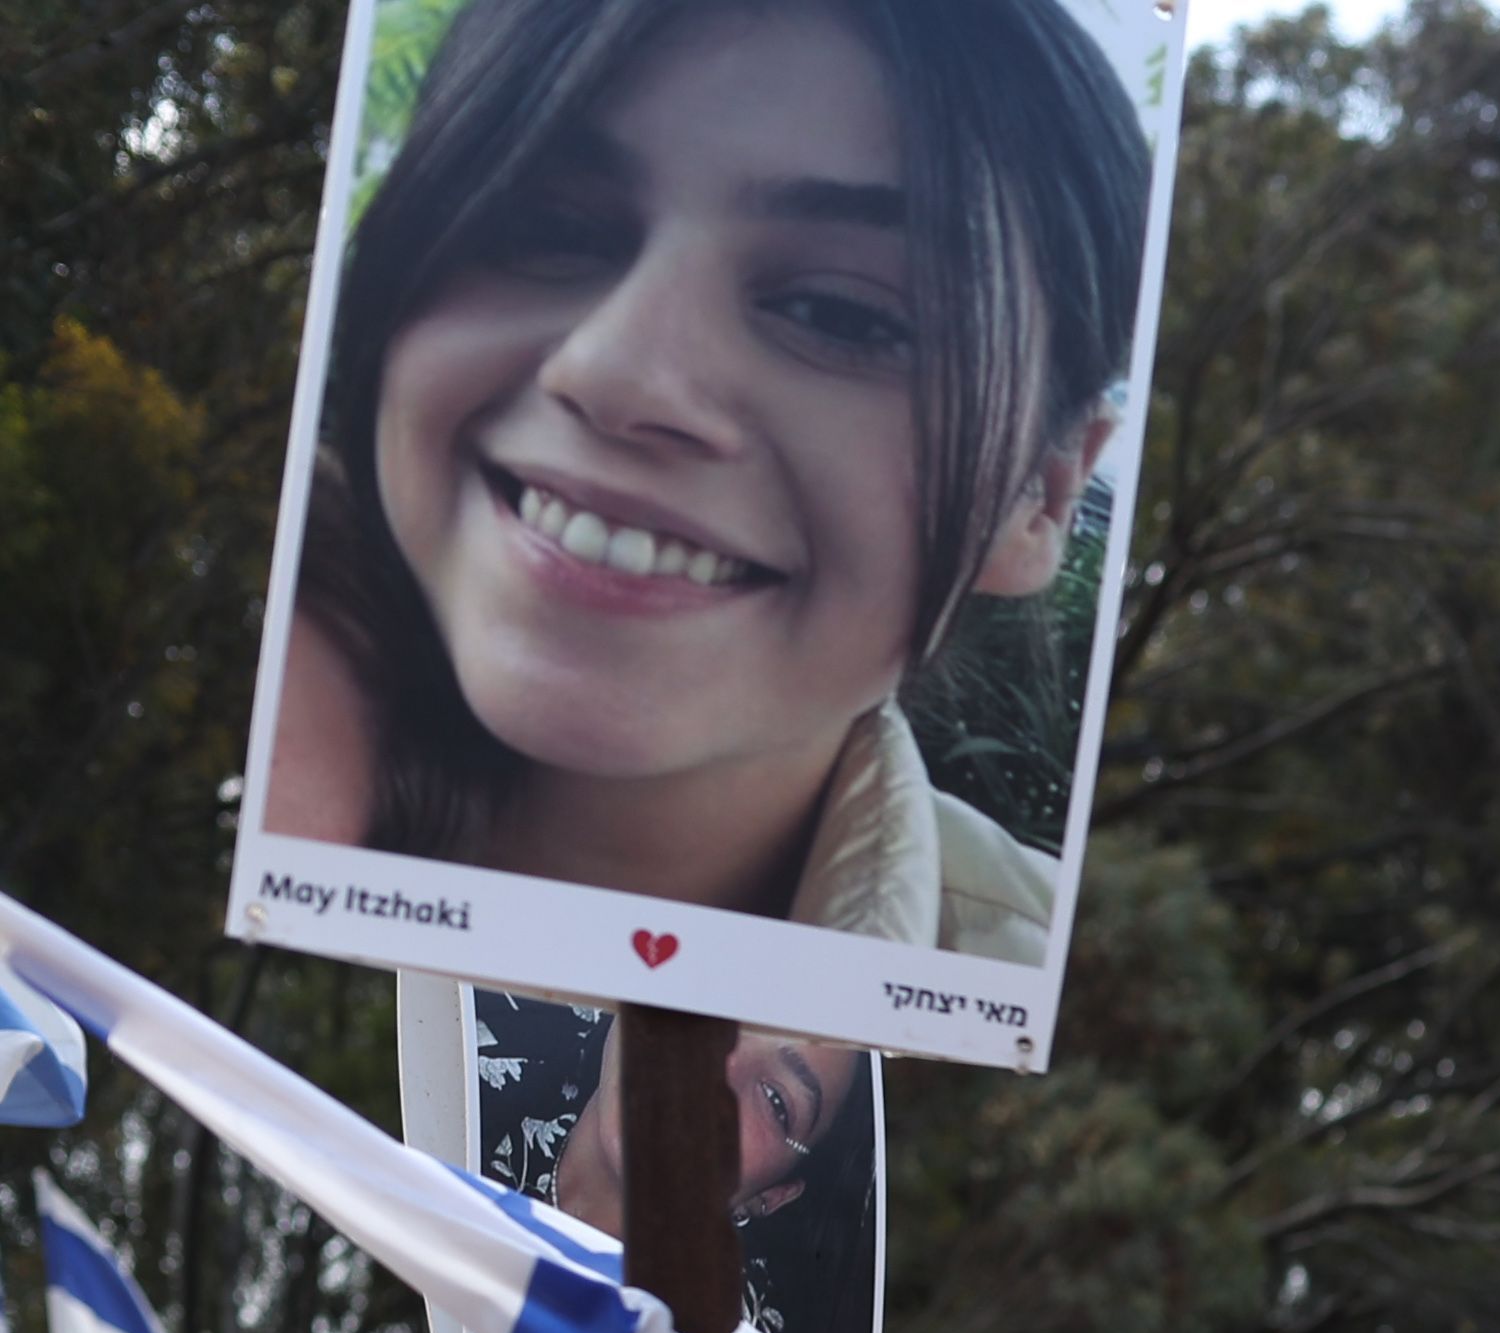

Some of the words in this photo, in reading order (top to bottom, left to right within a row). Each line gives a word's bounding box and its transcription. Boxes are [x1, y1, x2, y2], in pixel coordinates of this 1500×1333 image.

[259, 870, 336, 914] May
[344, 884, 471, 931] Itzhaki
[882, 981, 968, 1015] יצחקי
[975, 998, 1028, 1028] מאי
